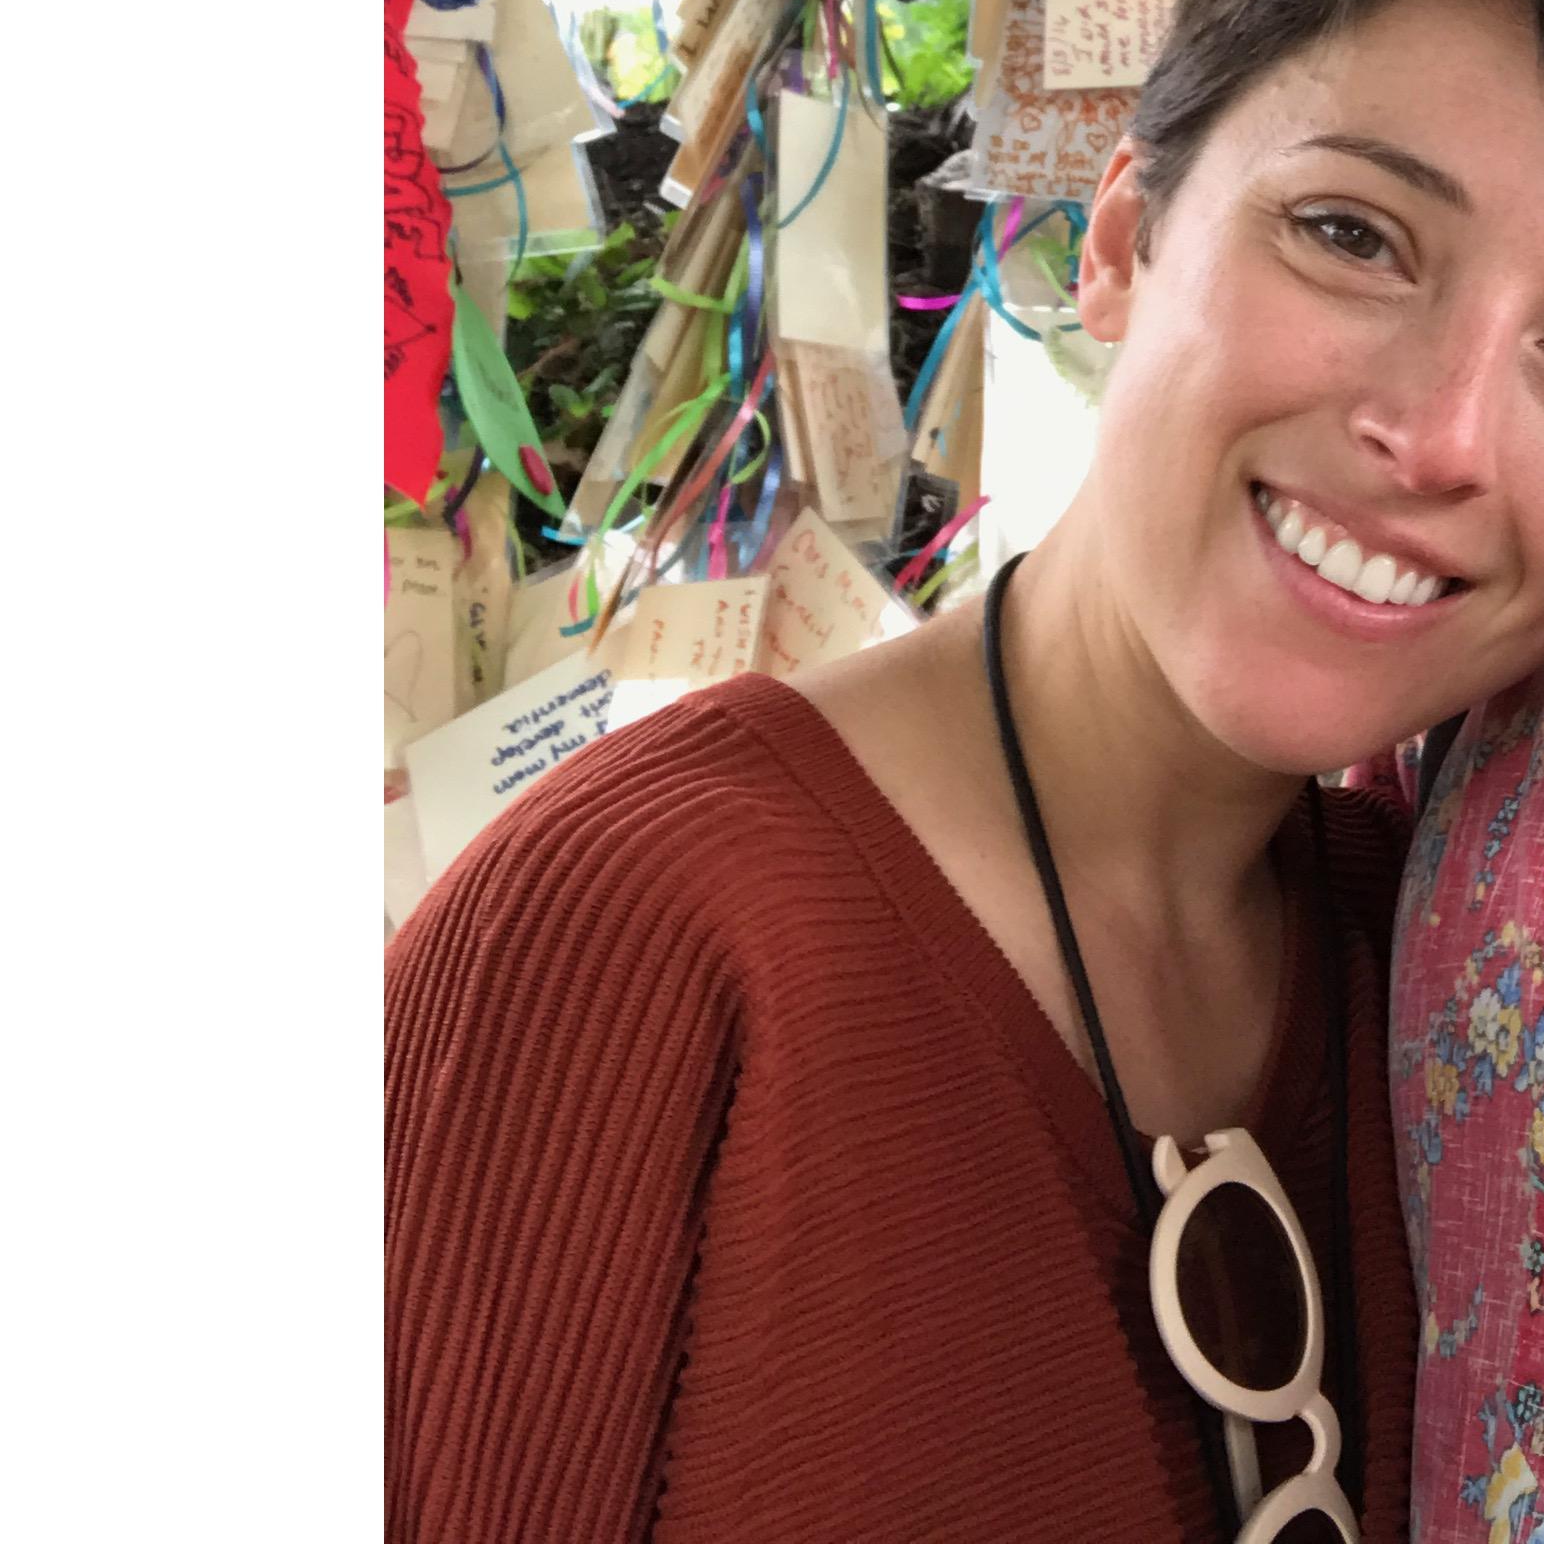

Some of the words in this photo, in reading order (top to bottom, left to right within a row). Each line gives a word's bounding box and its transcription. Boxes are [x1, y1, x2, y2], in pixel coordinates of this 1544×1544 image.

[501, 668, 613, 734] dementia
[490, 719, 566, 767] develop
[550, 733, 587, 762] my
